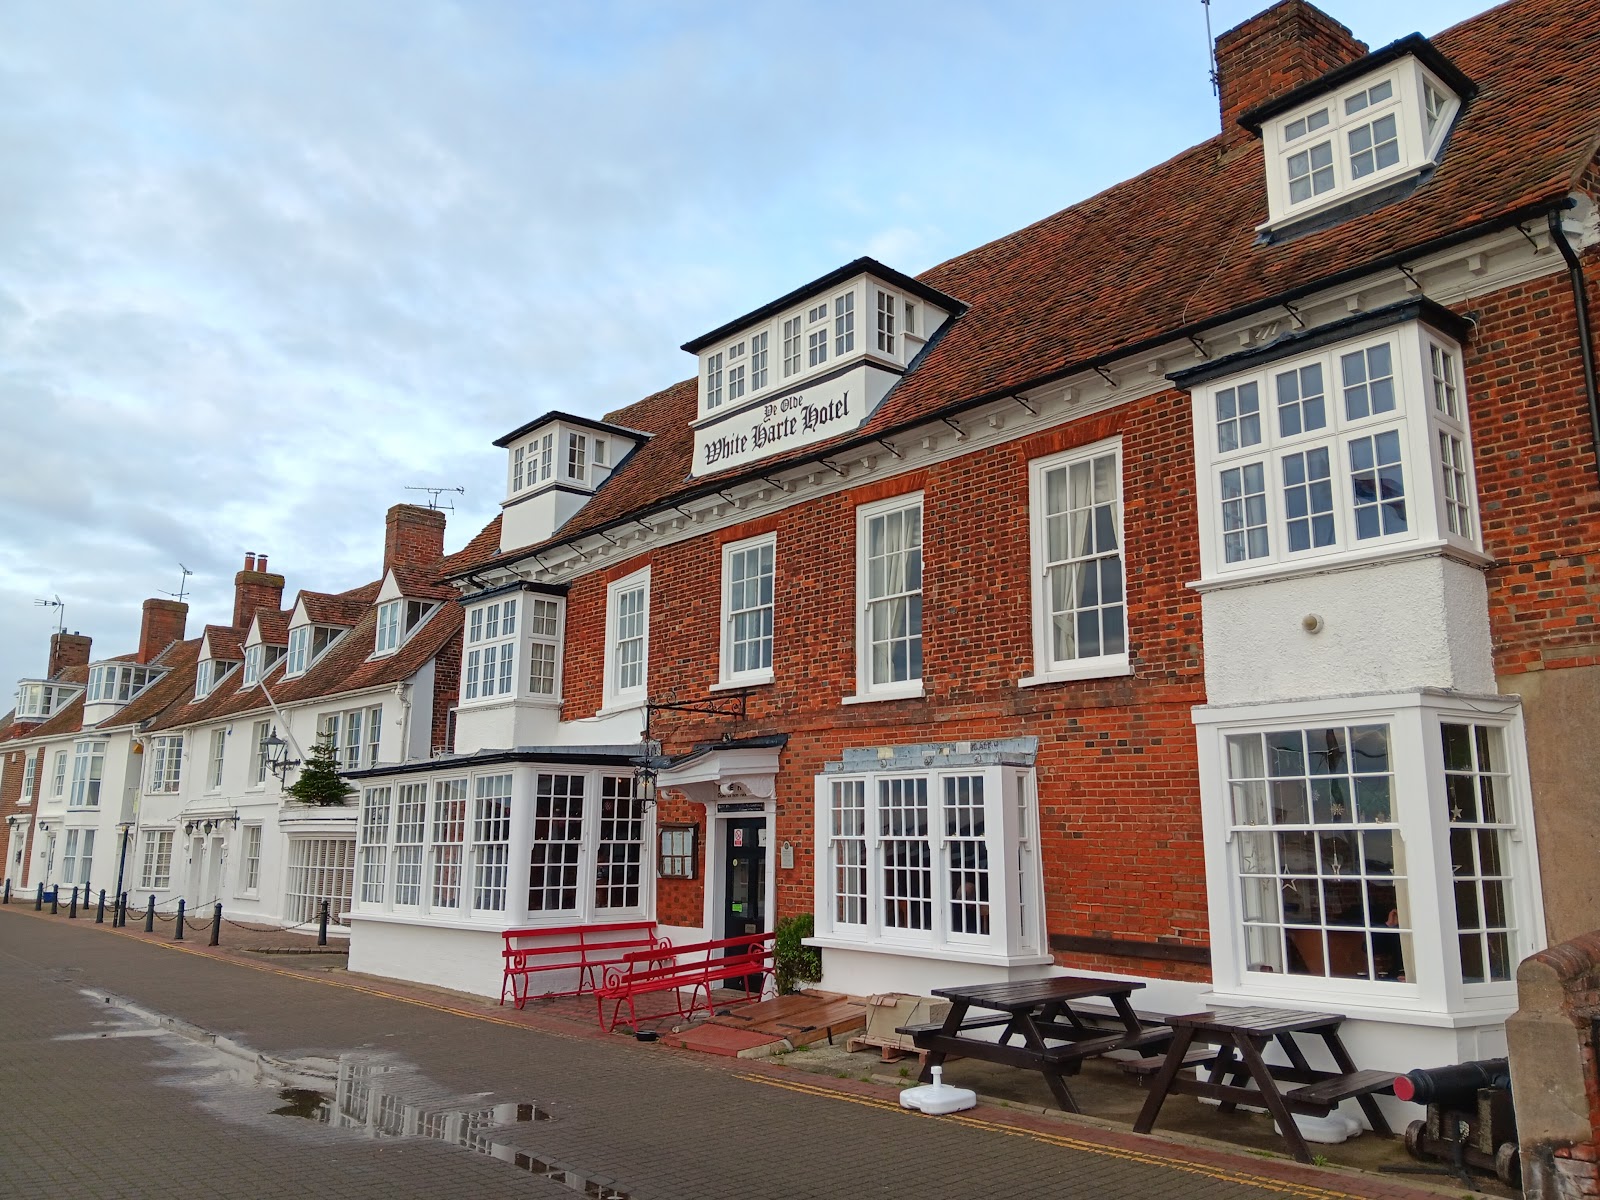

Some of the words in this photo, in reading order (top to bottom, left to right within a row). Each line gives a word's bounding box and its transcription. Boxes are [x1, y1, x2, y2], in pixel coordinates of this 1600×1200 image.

[704, 433, 747, 464] White
[752, 416, 796, 450] Harte
[800, 391, 849, 434] Hotel
[763, 404, 777, 423] Ye
[780, 395, 804, 412] Olde
